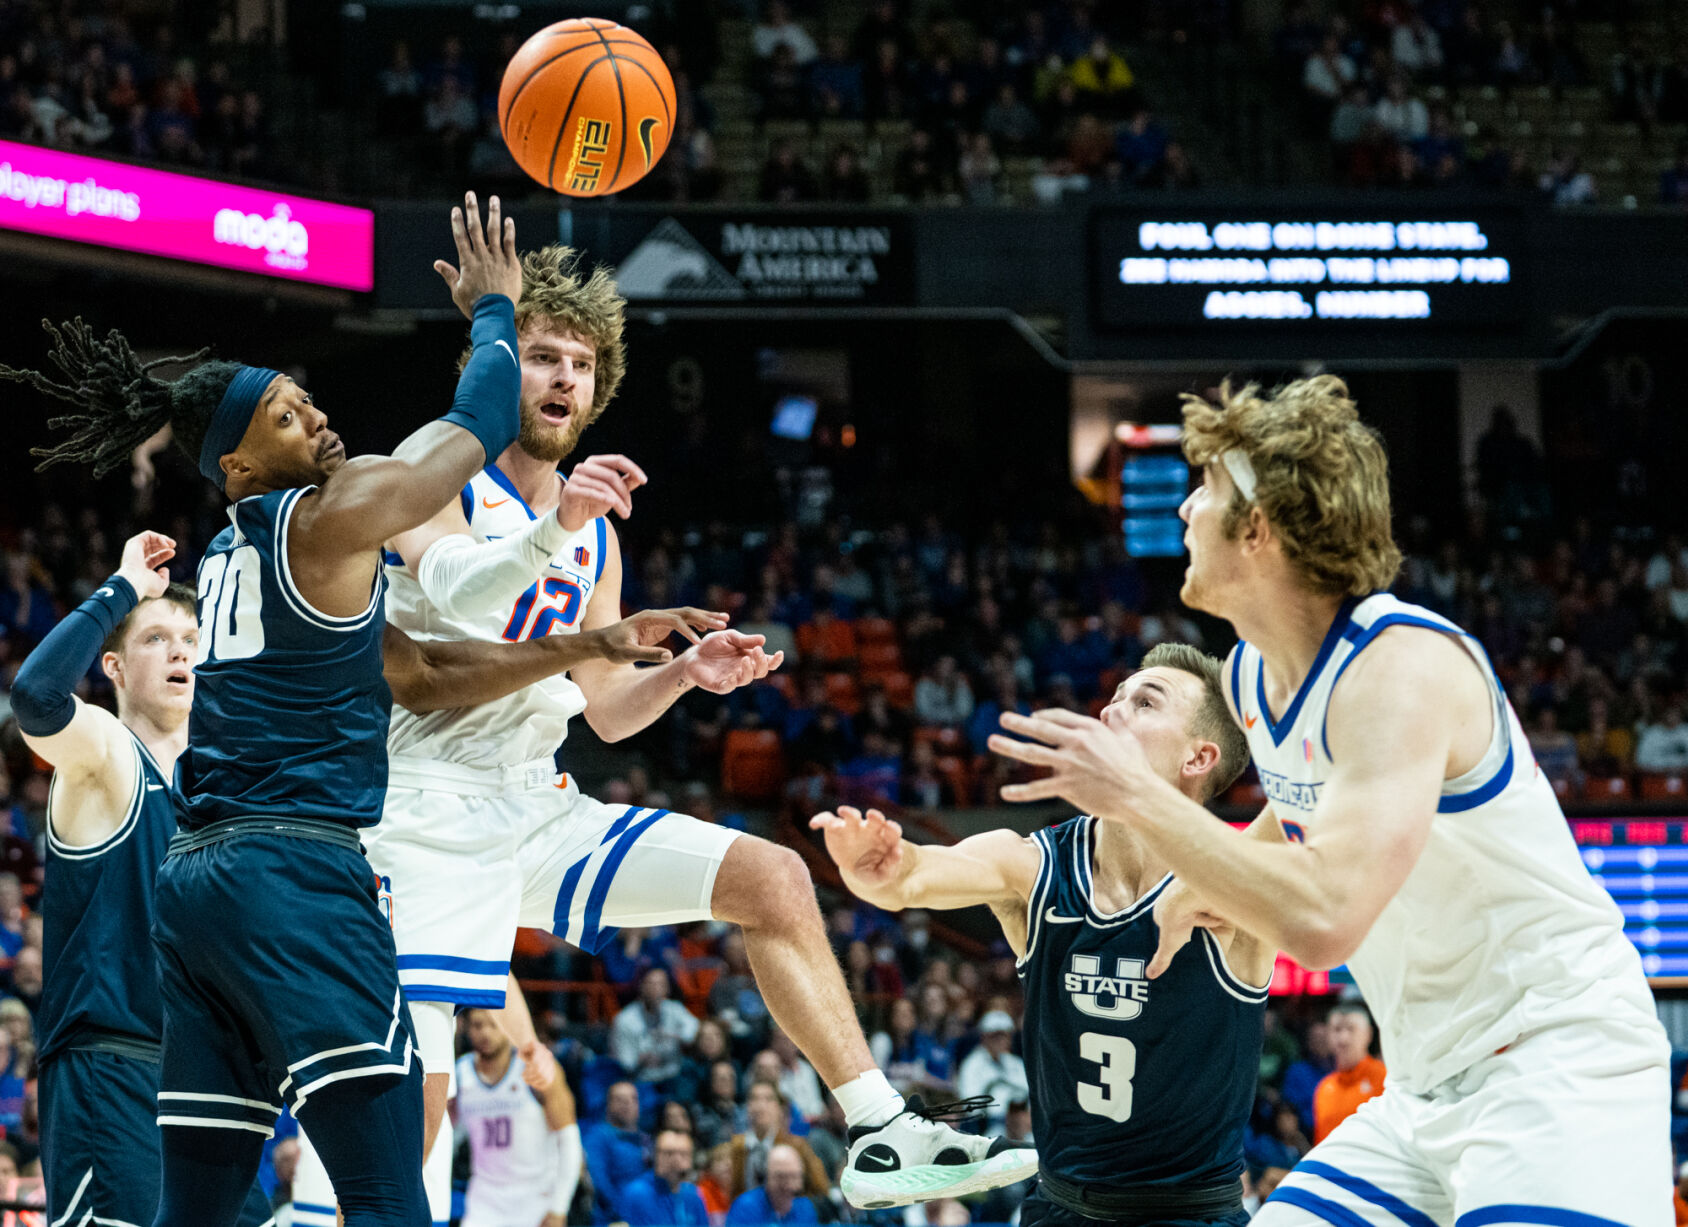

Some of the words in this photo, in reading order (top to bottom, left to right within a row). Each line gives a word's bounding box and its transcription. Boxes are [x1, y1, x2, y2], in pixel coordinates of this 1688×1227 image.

[570, 118, 612, 192] ELITE
[66, 176, 141, 222] plans
[213, 202, 309, 257] moda
[196, 545, 265, 664] 30
[501, 577, 582, 642] 12
[1064, 972, 1149, 1002] STATE
[1070, 954, 1145, 1021] U
[1077, 1031, 1136, 1123] 3
